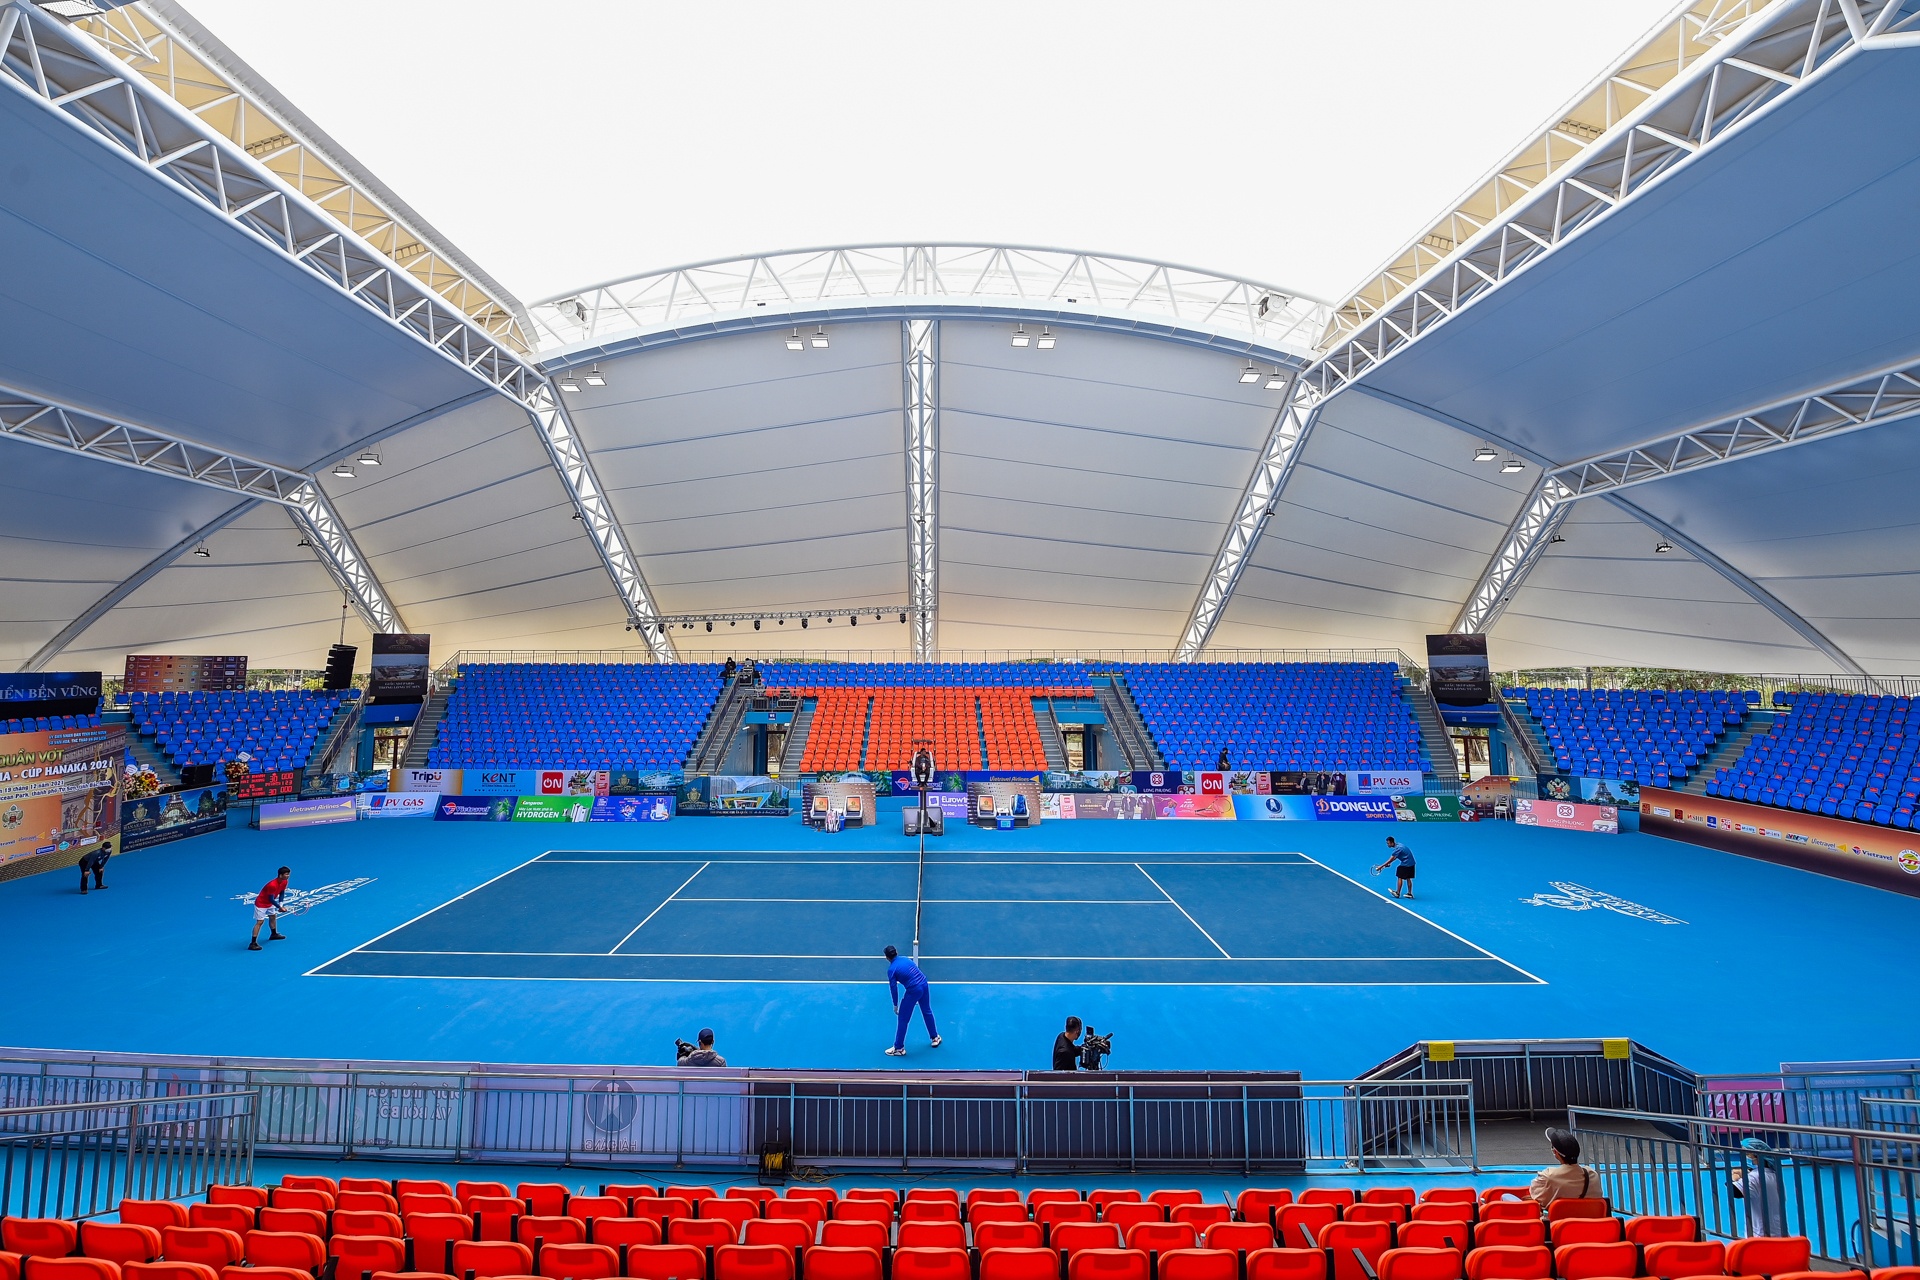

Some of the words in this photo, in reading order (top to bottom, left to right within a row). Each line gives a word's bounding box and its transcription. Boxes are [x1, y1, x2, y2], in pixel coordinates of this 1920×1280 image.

[60, 684, 98, 698] VỮNG
[39, 748, 64, 765] VỢT
[21, 766, 42, 780] CÚP
[45, 762, 88, 776] HANAKA
[90, 760, 113, 769] 2021
[384, 798, 400, 806] PV
[403, 798, 424, 806] GAS
[1330, 801, 1392, 812] DONGLUC
[1862, 850, 1893, 860] Vietravel
